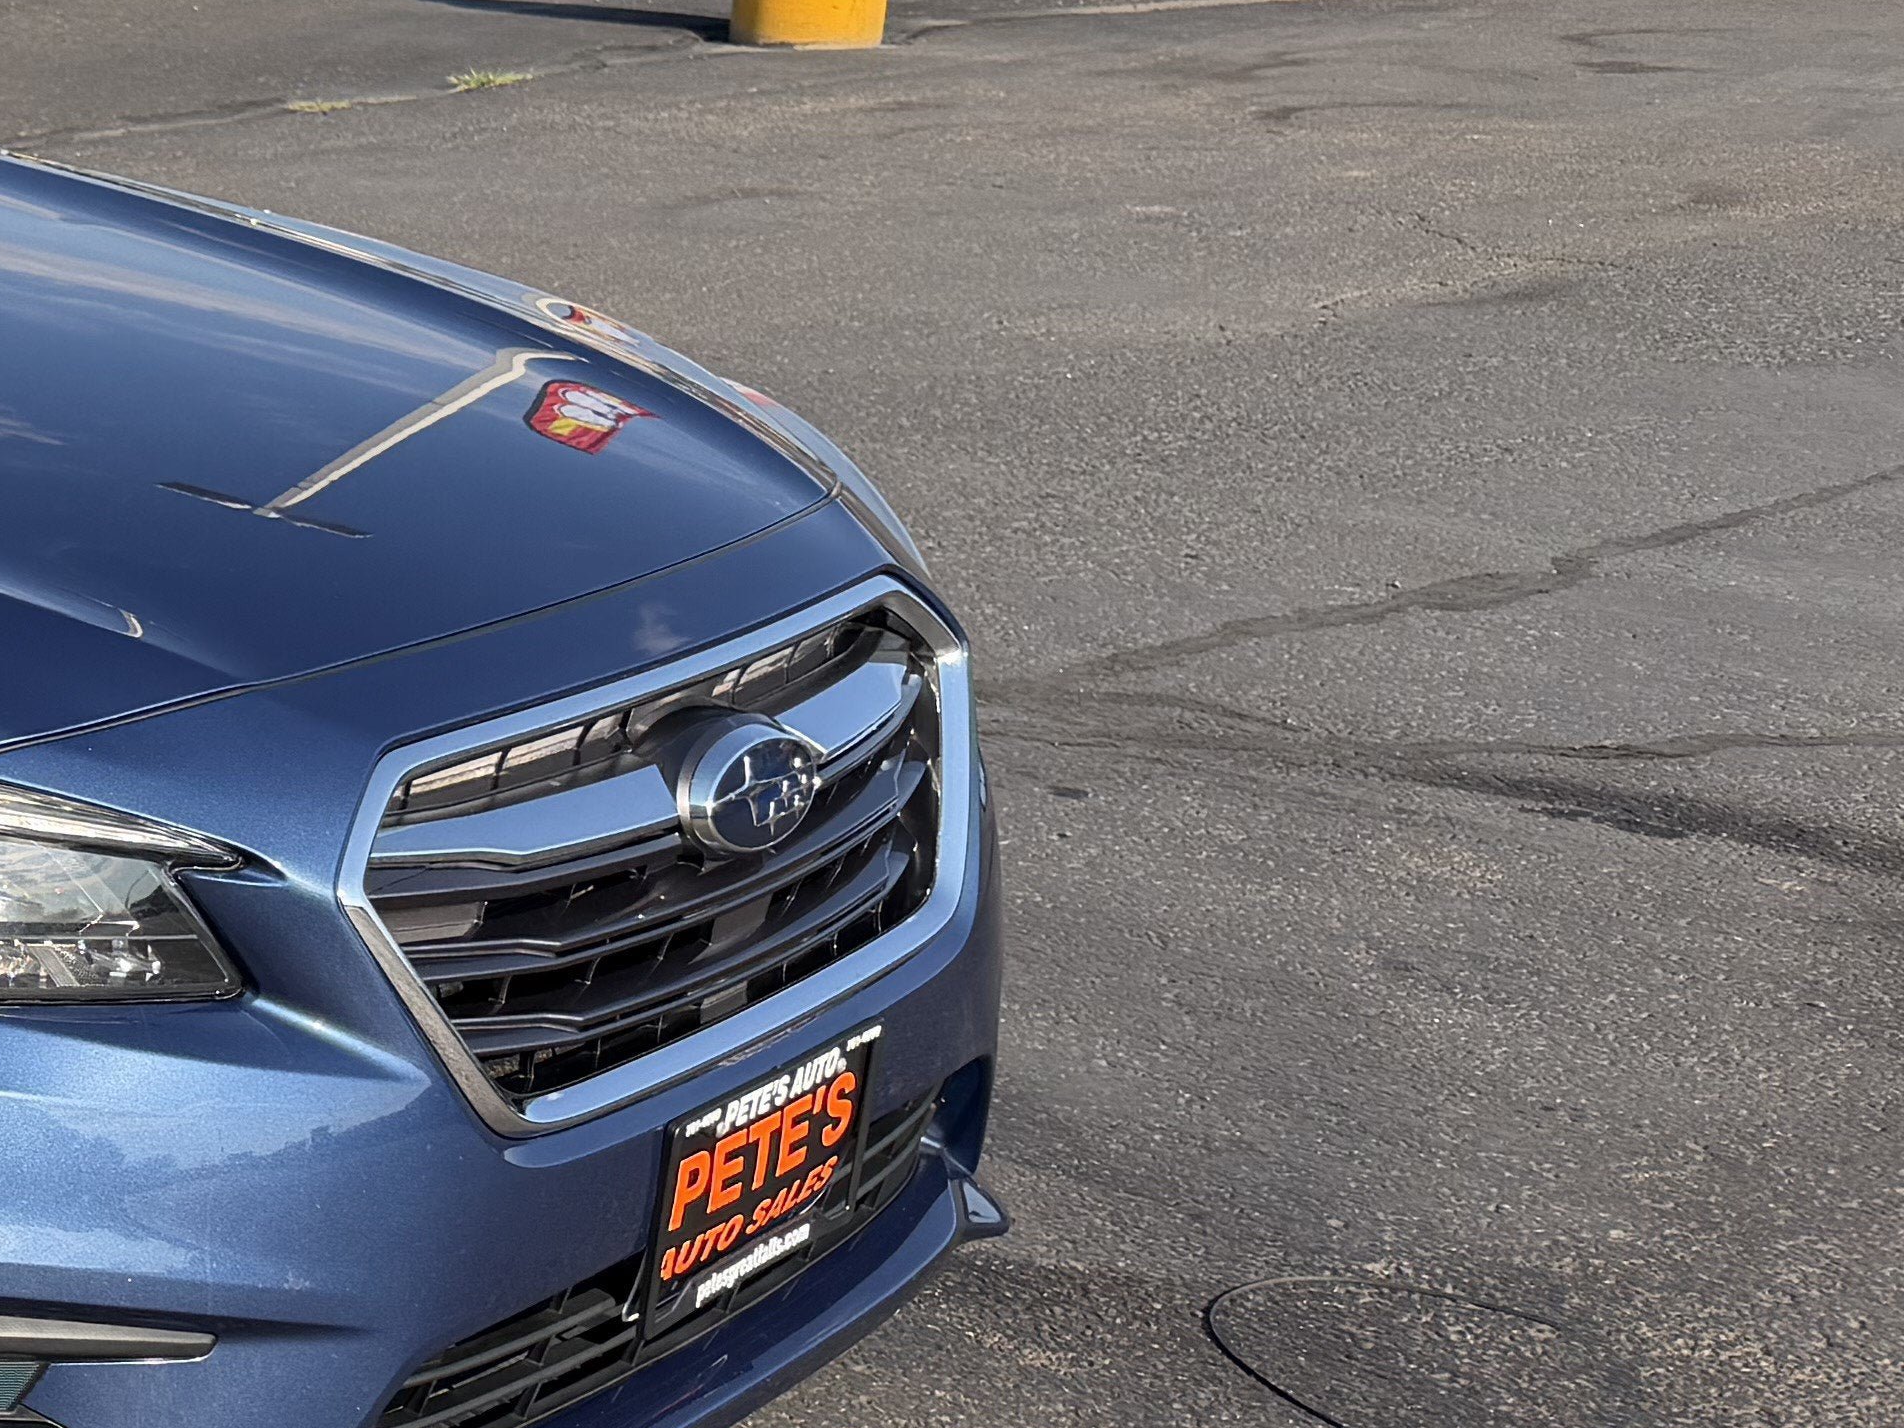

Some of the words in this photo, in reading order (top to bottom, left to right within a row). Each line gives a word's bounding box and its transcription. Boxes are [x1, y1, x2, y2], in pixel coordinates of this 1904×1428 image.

[722, 1074, 791, 1127] PETE'S
[789, 1047, 842, 1098] AUTO
[668, 1071, 857, 1232] PETE'S
[660, 1214, 744, 1281] AUTO
[745, 1155, 838, 1235] SALES
